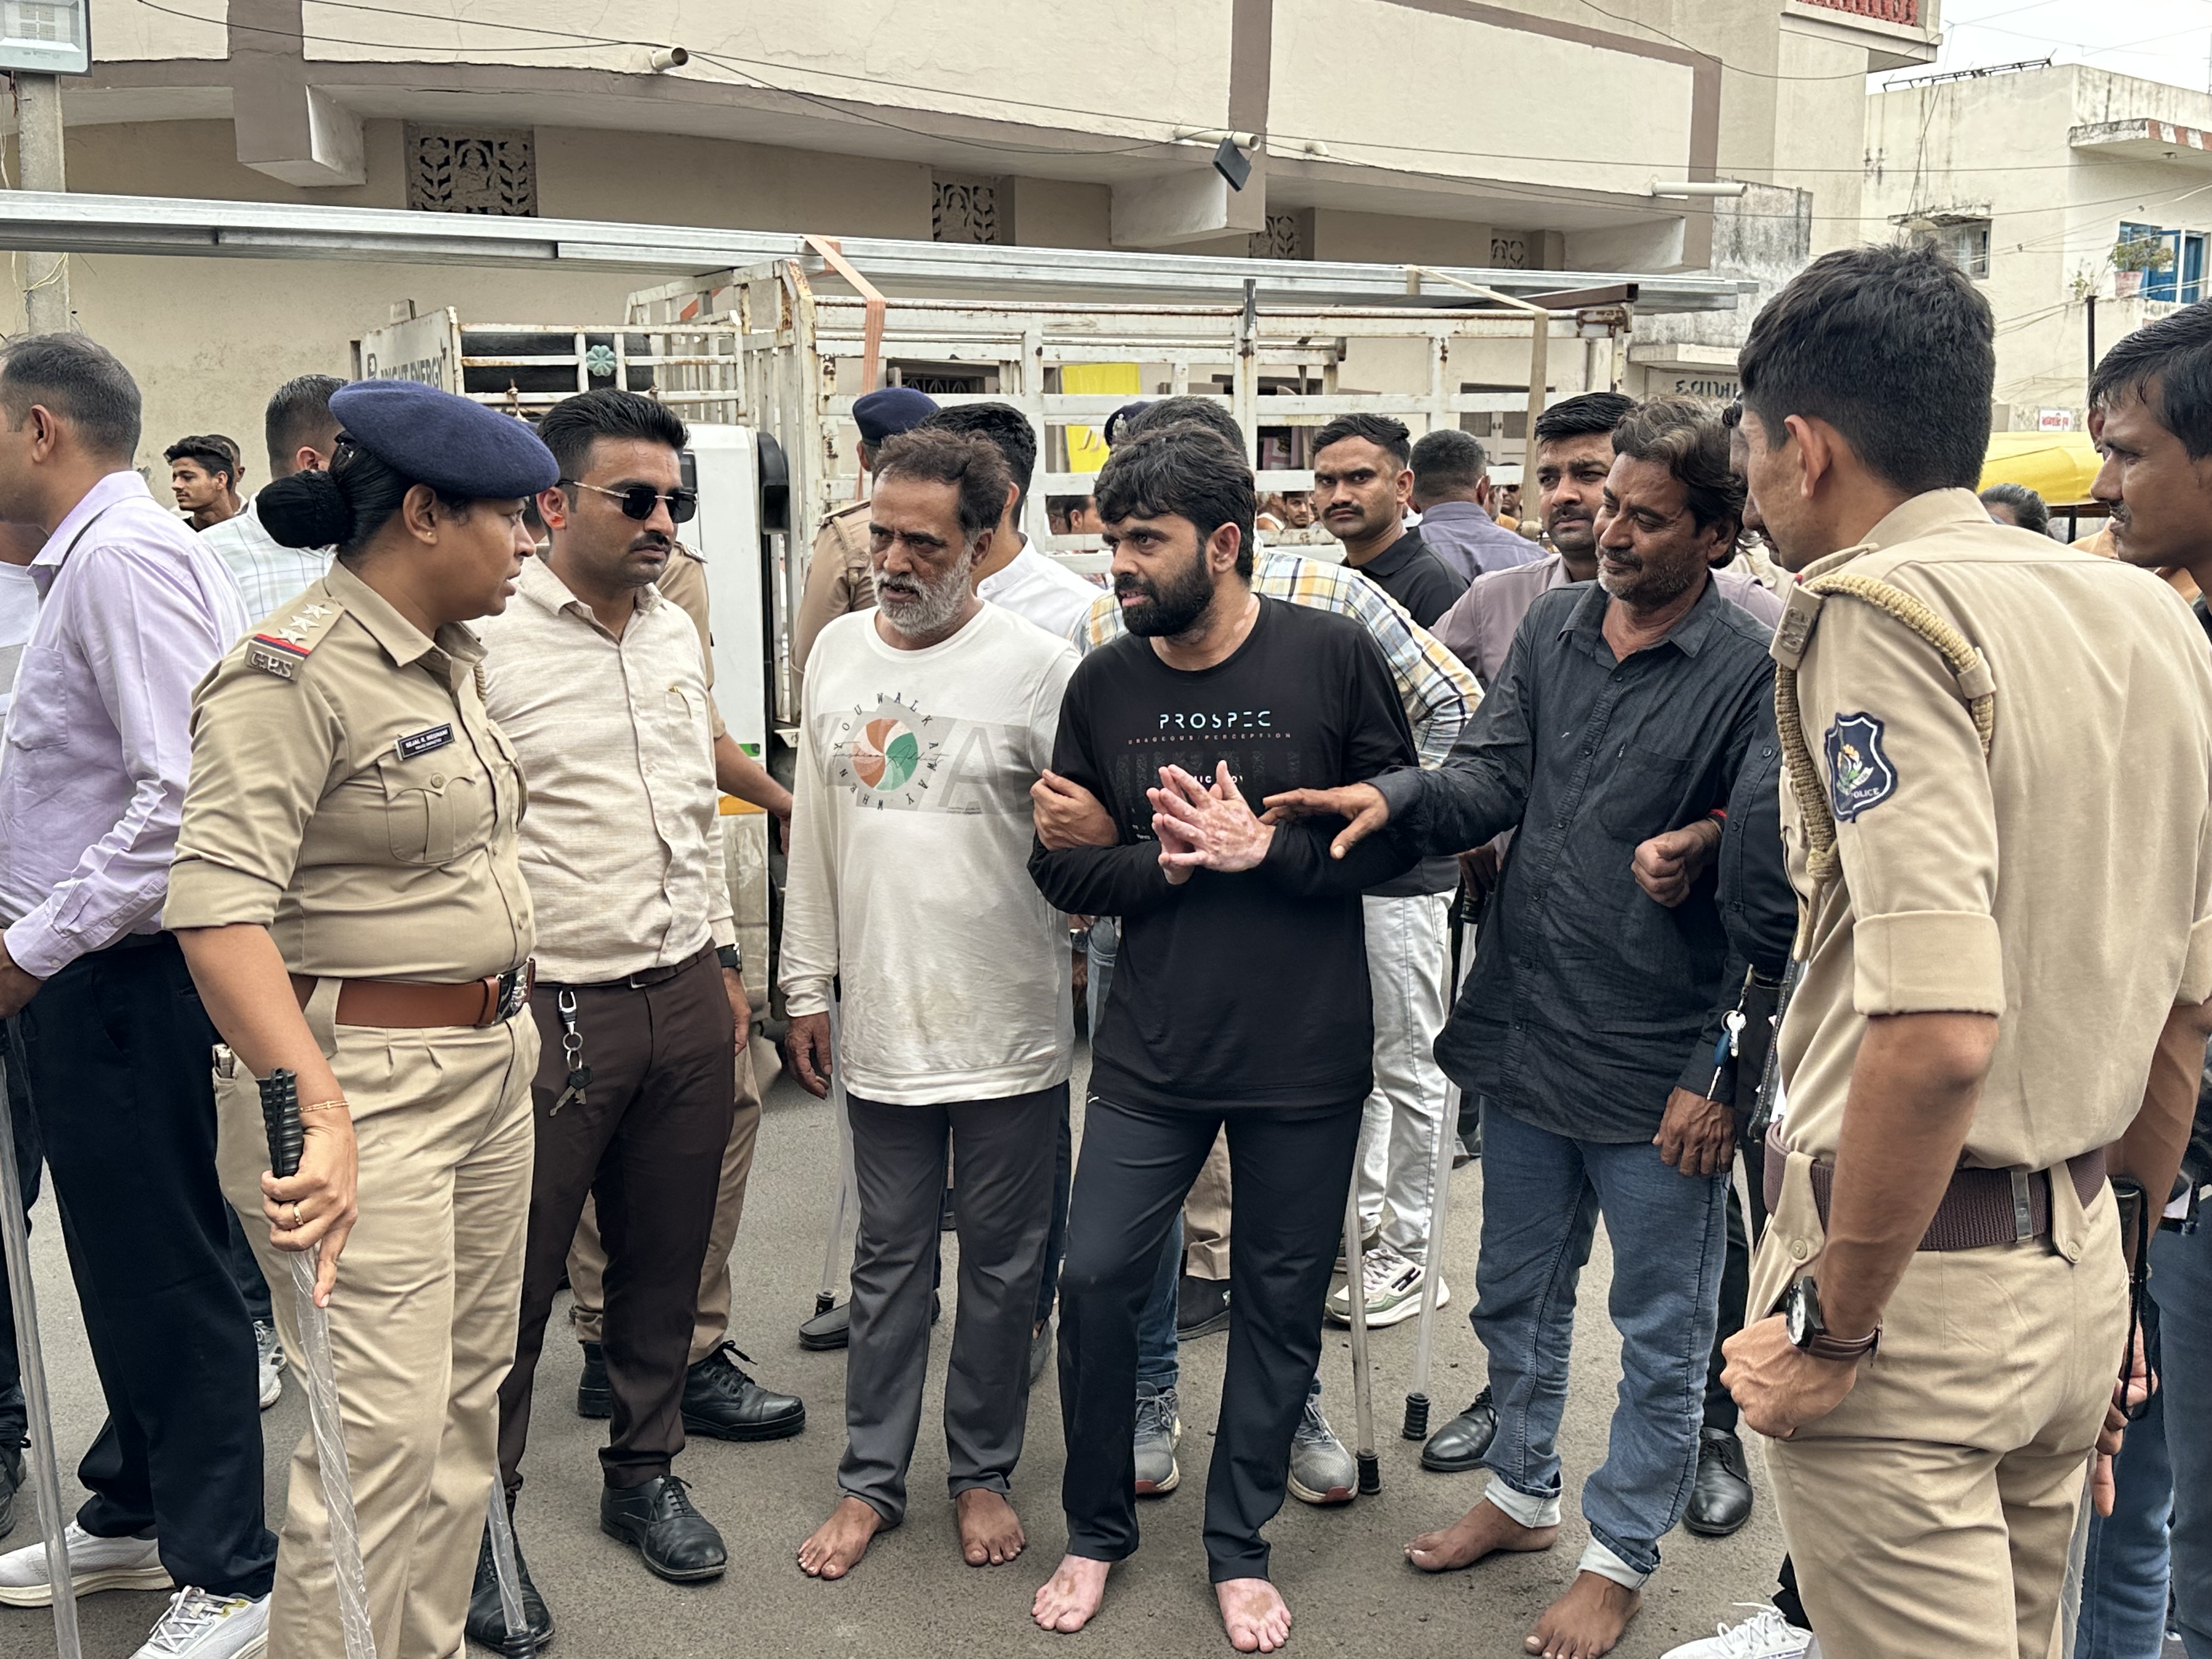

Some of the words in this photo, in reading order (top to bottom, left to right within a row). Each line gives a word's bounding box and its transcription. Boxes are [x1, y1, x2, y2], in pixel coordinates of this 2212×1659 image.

[877, 692, 933, 726] WALK
[906, 742, 939, 805] AWAY
[1159, 711, 1271, 729] PROSPEC
